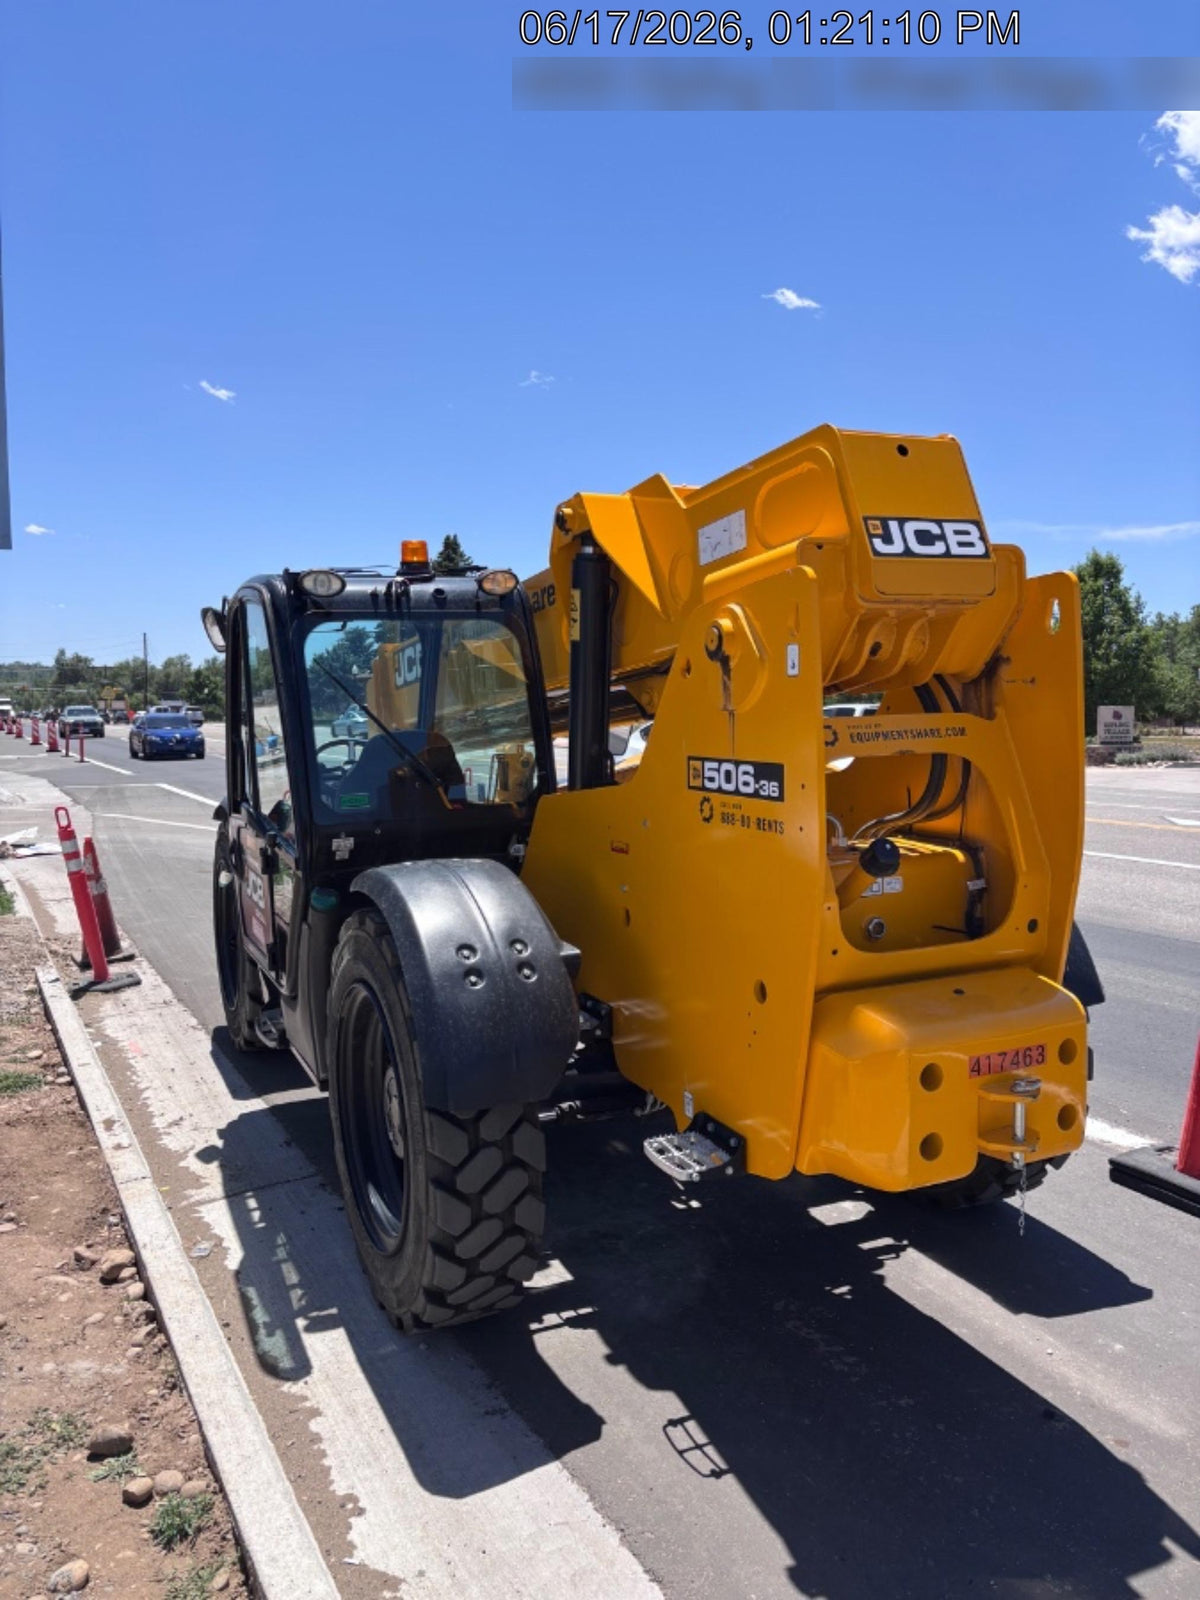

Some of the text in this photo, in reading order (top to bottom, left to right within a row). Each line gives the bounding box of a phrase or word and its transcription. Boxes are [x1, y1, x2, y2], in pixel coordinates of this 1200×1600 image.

[872, 520, 986, 556] JCB
[850, 726, 967, 744] EQUIPMENTSHARE.COM
[970, 1044, 1046, 1077] 417463
